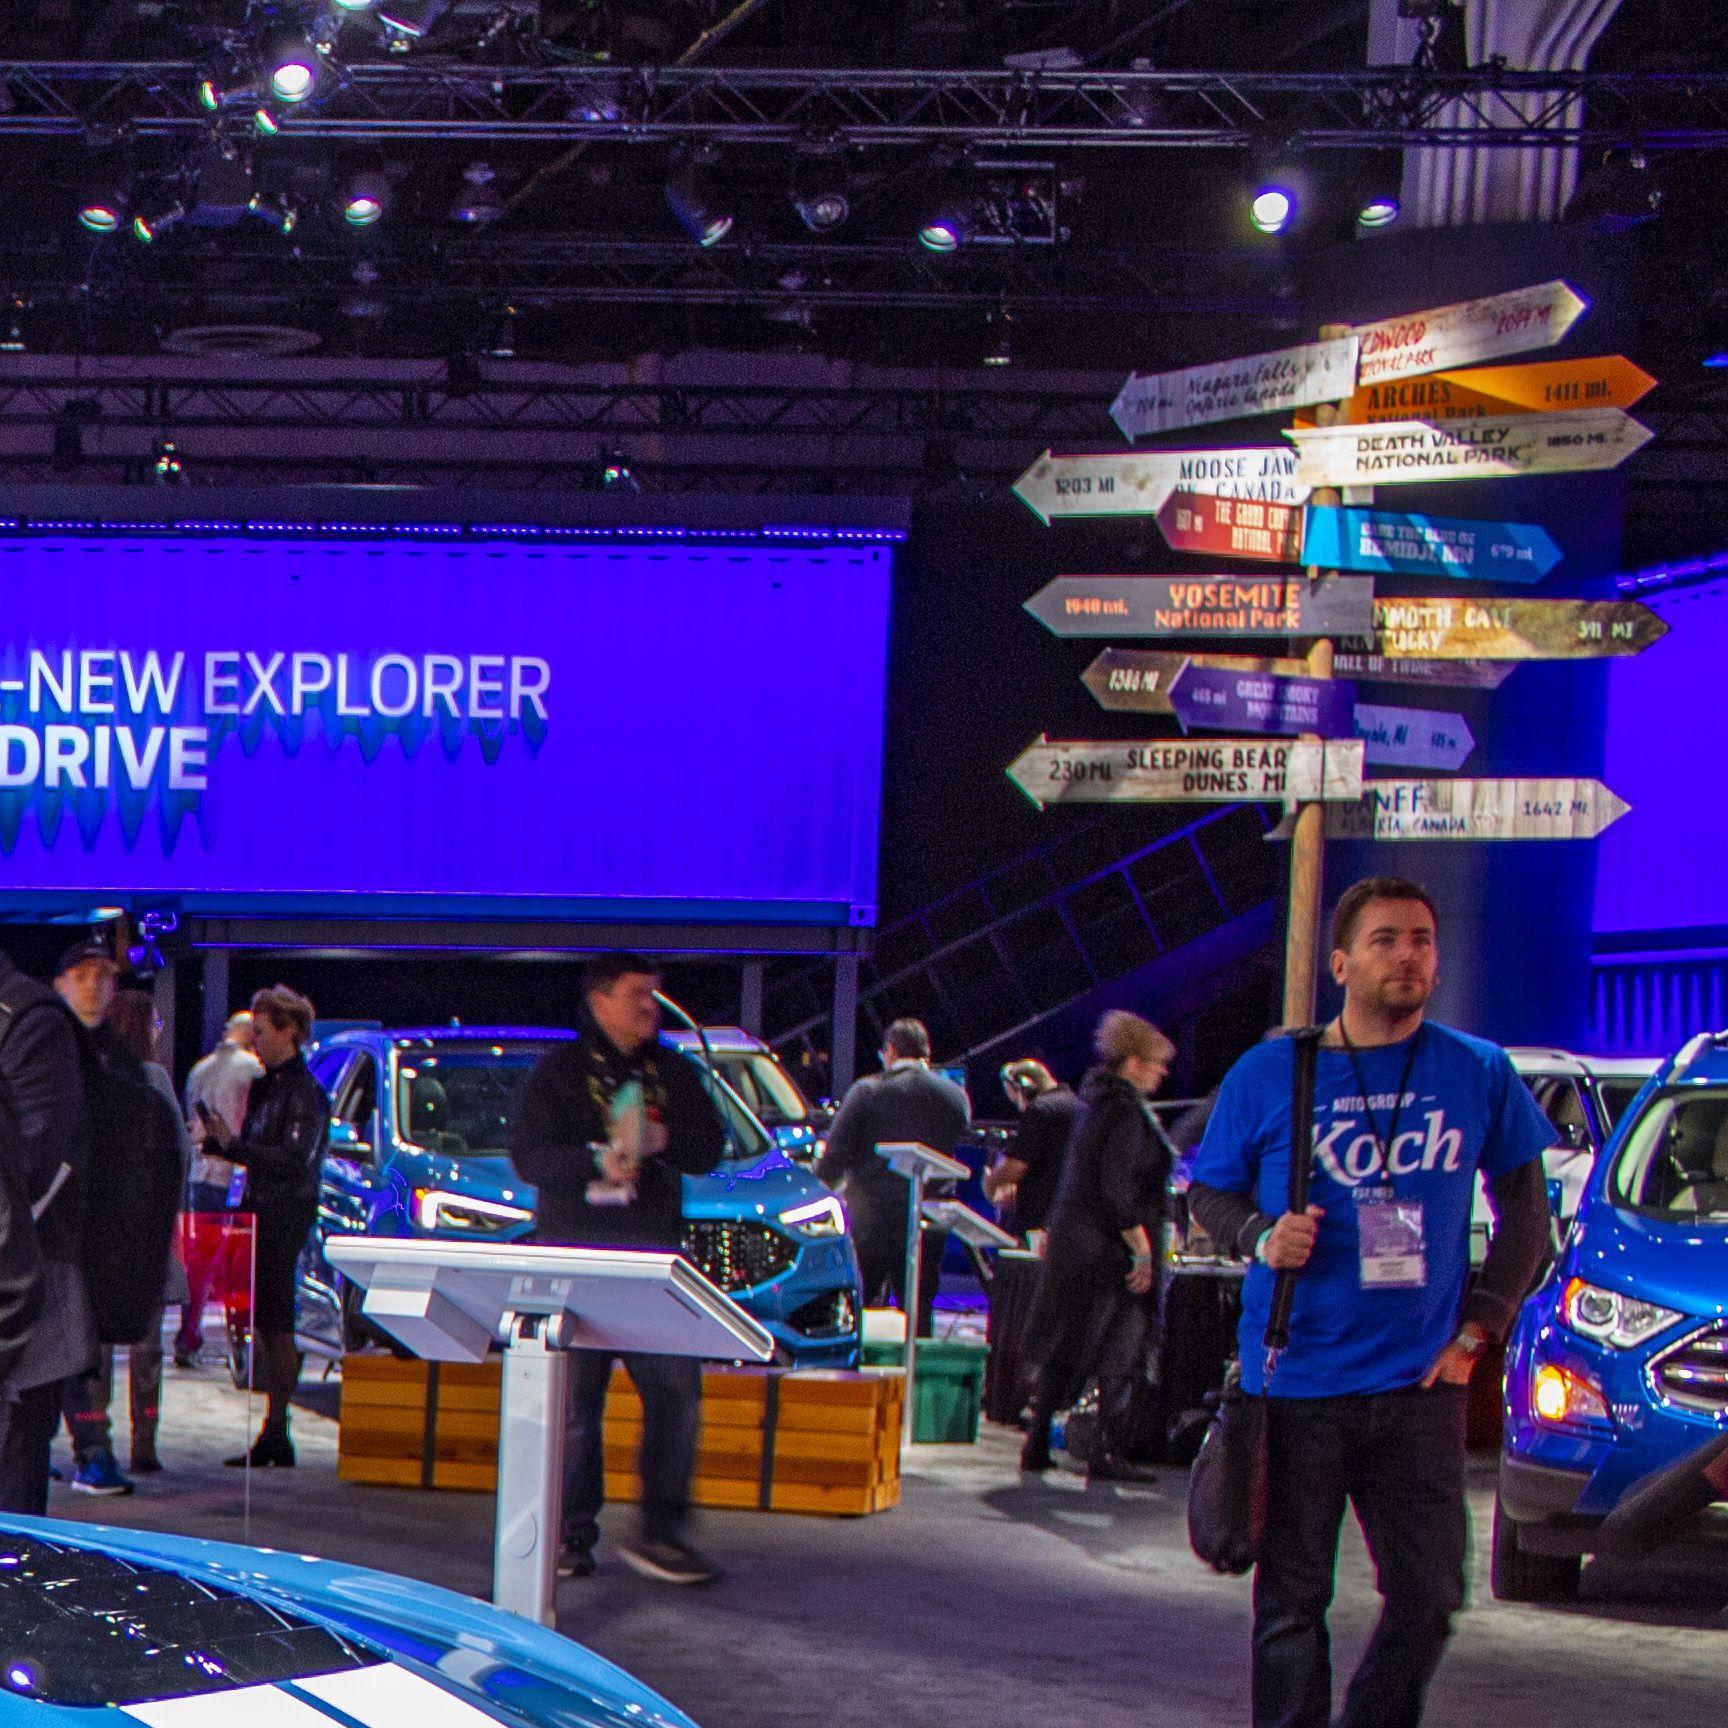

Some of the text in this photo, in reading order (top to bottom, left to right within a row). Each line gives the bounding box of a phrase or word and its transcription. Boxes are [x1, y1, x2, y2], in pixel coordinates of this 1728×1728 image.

[1367, 380, 1451, 410] ARCHES
[1356, 434, 1424, 453] DEATH
[1430, 427, 1511, 448] VALLEY
[1179, 457, 1247, 481] MOOSE
[1258, 455, 1296, 478] JAW
[1356, 444, 1522, 471] NATIONAL PARK
[1168, 583, 1302, 609] YOSEMITE
[1154, 607, 1302, 629] National Park
[202, 650, 552, 721] EXPLORER
[1048, 760, 1087, 781] 230
[1126, 748, 1224, 769] SLEEPING
[1231, 747, 1287, 769] BEAR
[1262, 772, 1287, 792] MI
[1523, 800, 1563, 817] 1642
[1311, 1108, 1464, 1187] Koch
